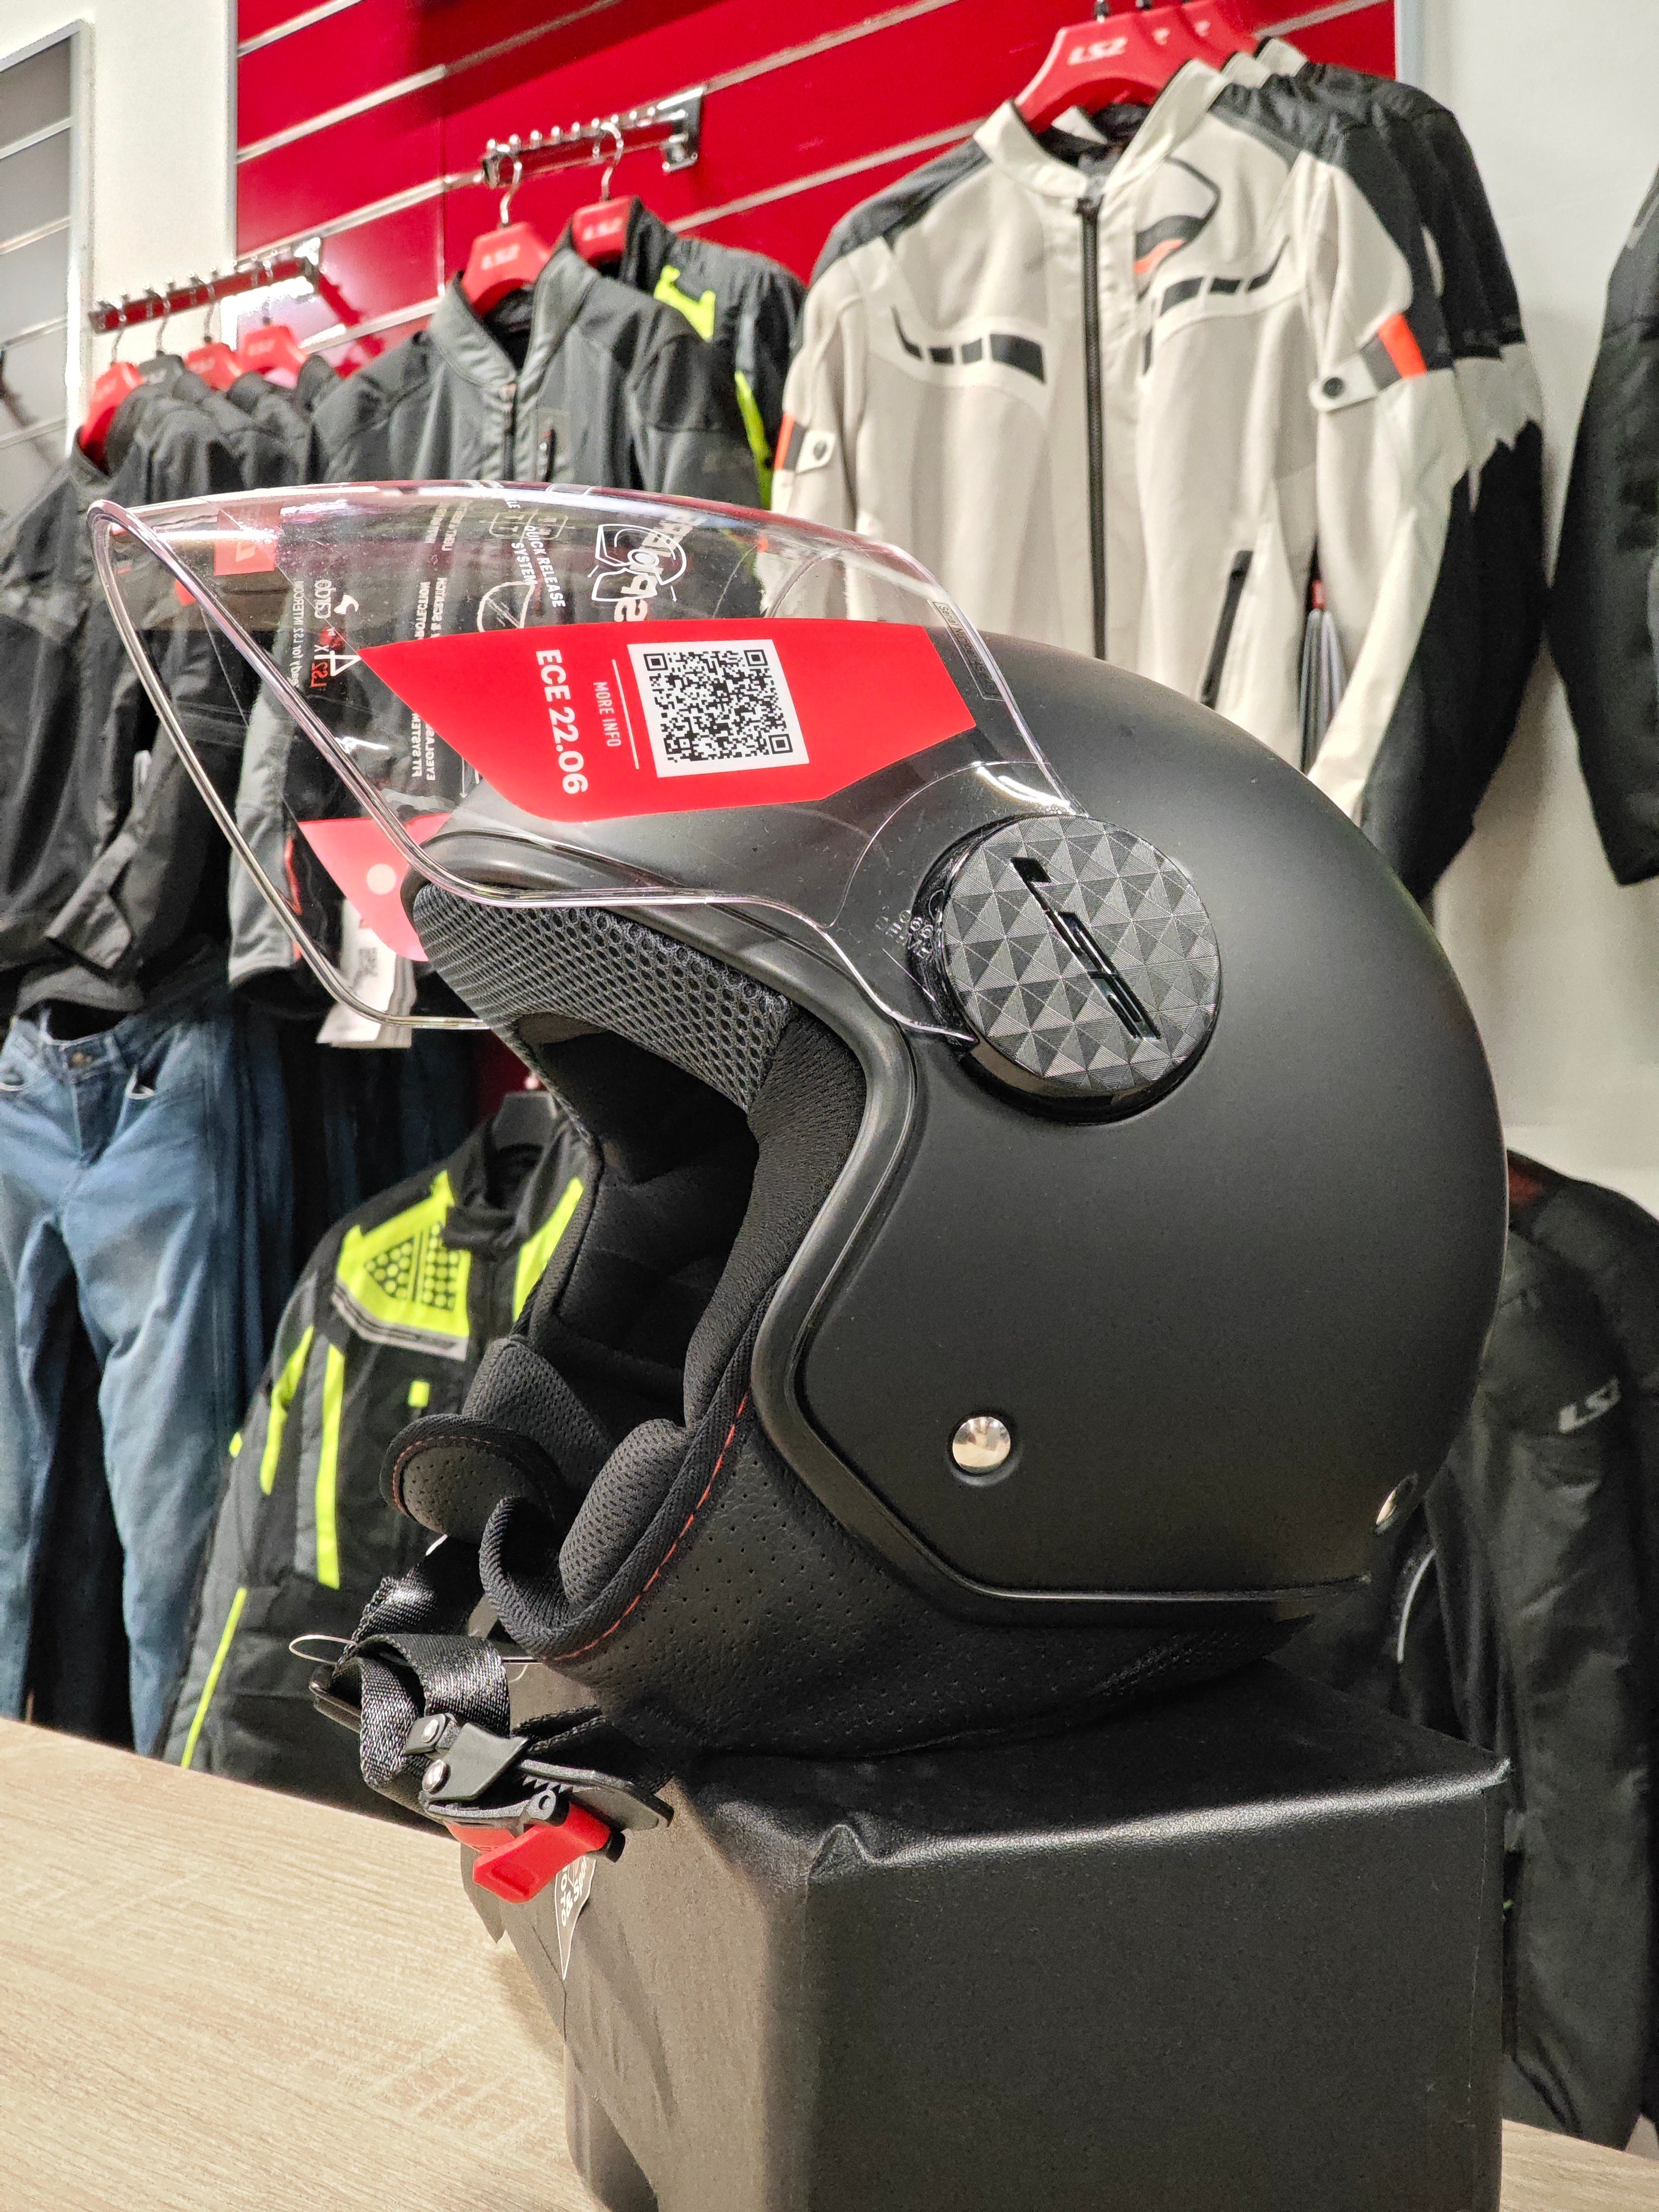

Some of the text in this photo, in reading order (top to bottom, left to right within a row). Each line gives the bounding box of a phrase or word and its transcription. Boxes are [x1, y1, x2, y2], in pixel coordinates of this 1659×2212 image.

[511, 542, 538, 585] SYSTEM
[524, 525, 566, 608] QUICK RELEASE
[939, 606, 959, 626] Serial
[535, 649, 589, 794] ECE 22.06
[593, 682, 622, 747] MORE INFO
